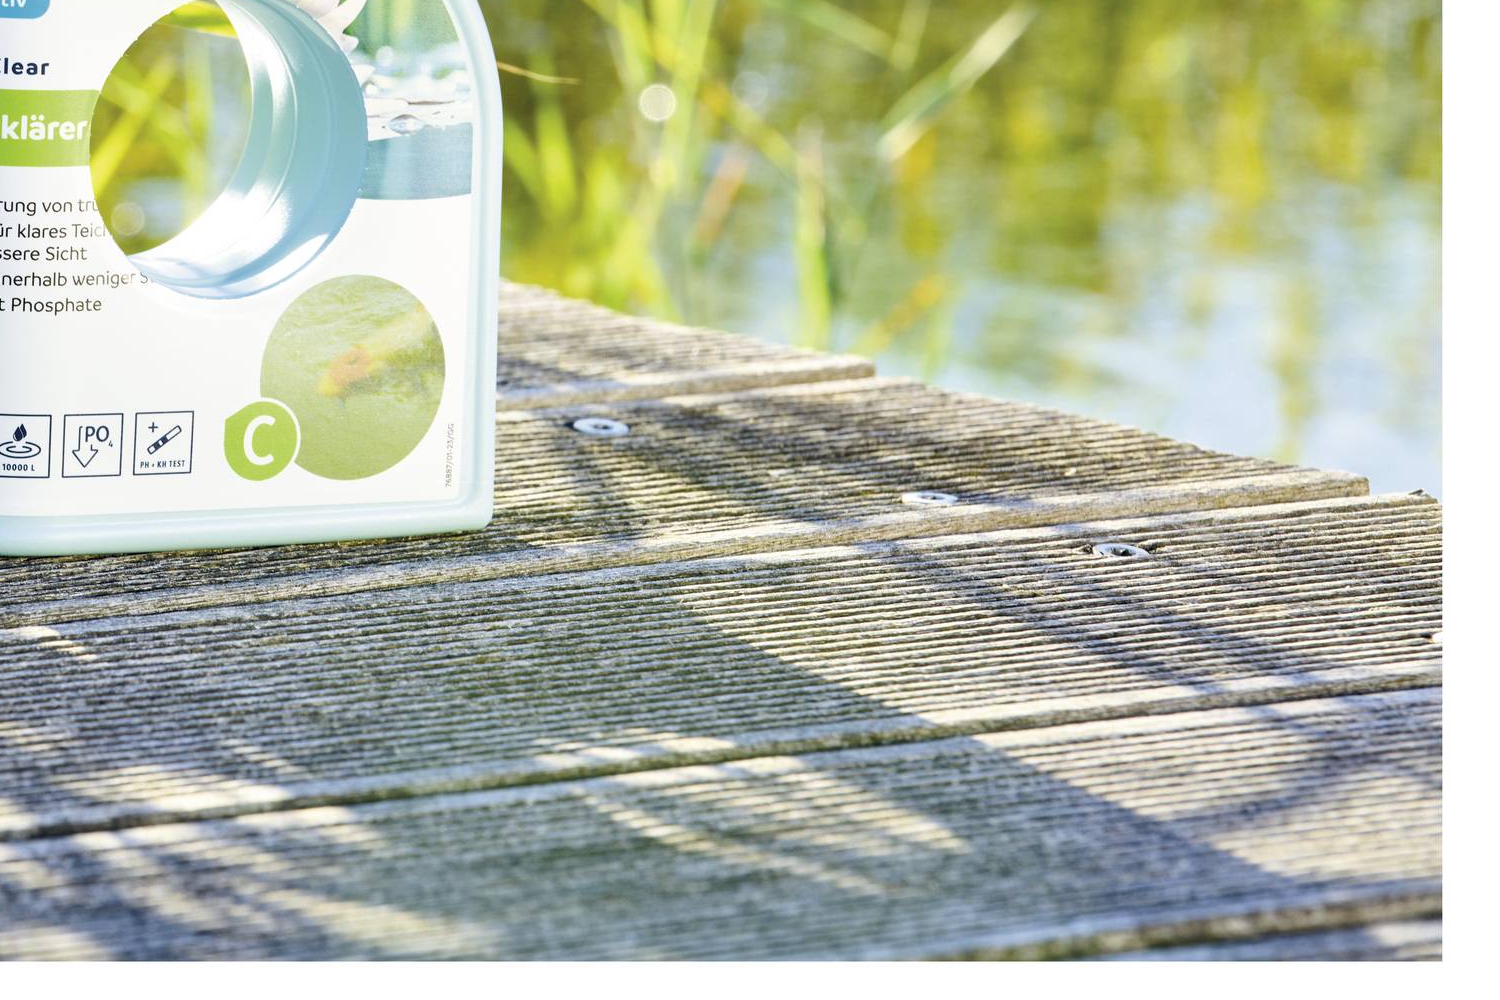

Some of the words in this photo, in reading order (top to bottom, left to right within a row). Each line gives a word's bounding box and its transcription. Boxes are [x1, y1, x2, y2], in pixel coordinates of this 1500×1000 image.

[42, 200, 73, 213] von
[17, 223, 67, 239] klares
[45, 246, 88, 262] Sicht
[73, 270, 136, 289] weniger
[11, 297, 103, 317] Phosphate
[243, 414, 276, 466] C
[2, 463, 29, 472] 10000
[168, 459, 186, 468] TEST
